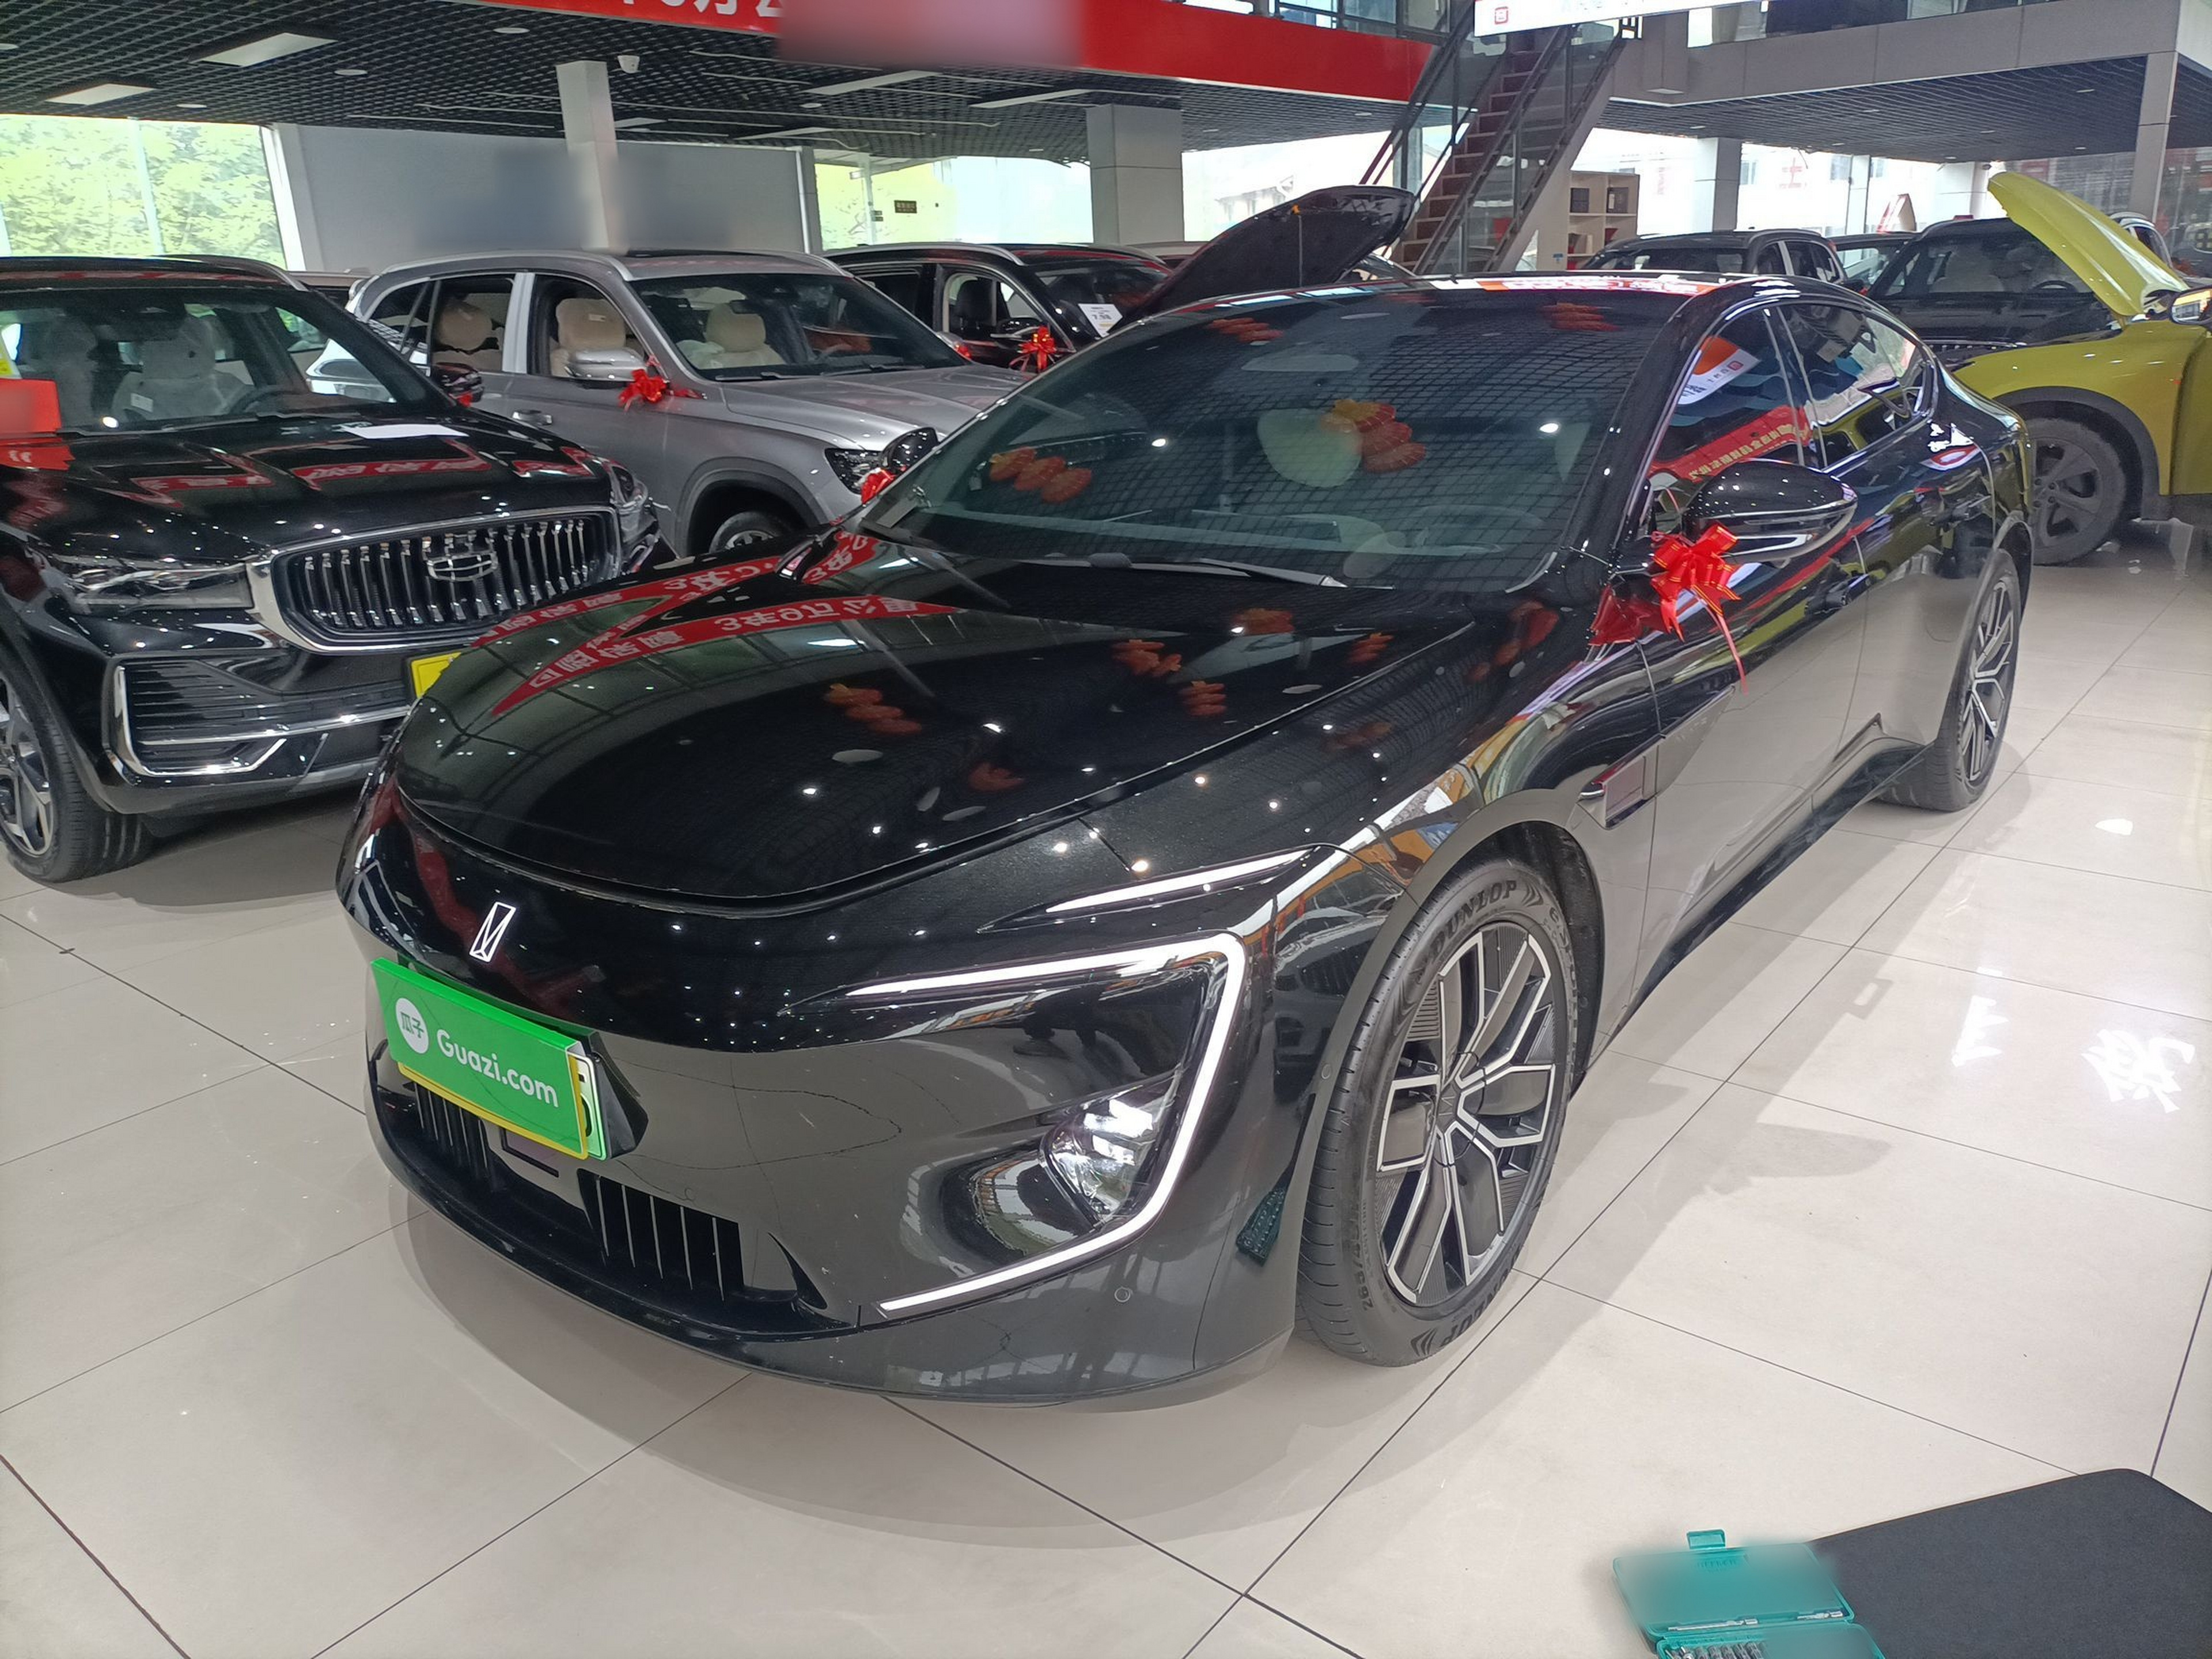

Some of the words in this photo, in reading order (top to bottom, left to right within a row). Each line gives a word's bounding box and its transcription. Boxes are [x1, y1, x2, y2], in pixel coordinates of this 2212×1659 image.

[1430, 880, 1516, 961] DUNLOP
[400, 1012, 425, 1039] 瓜子
[437, 1029, 559, 1108] Guazi.com
